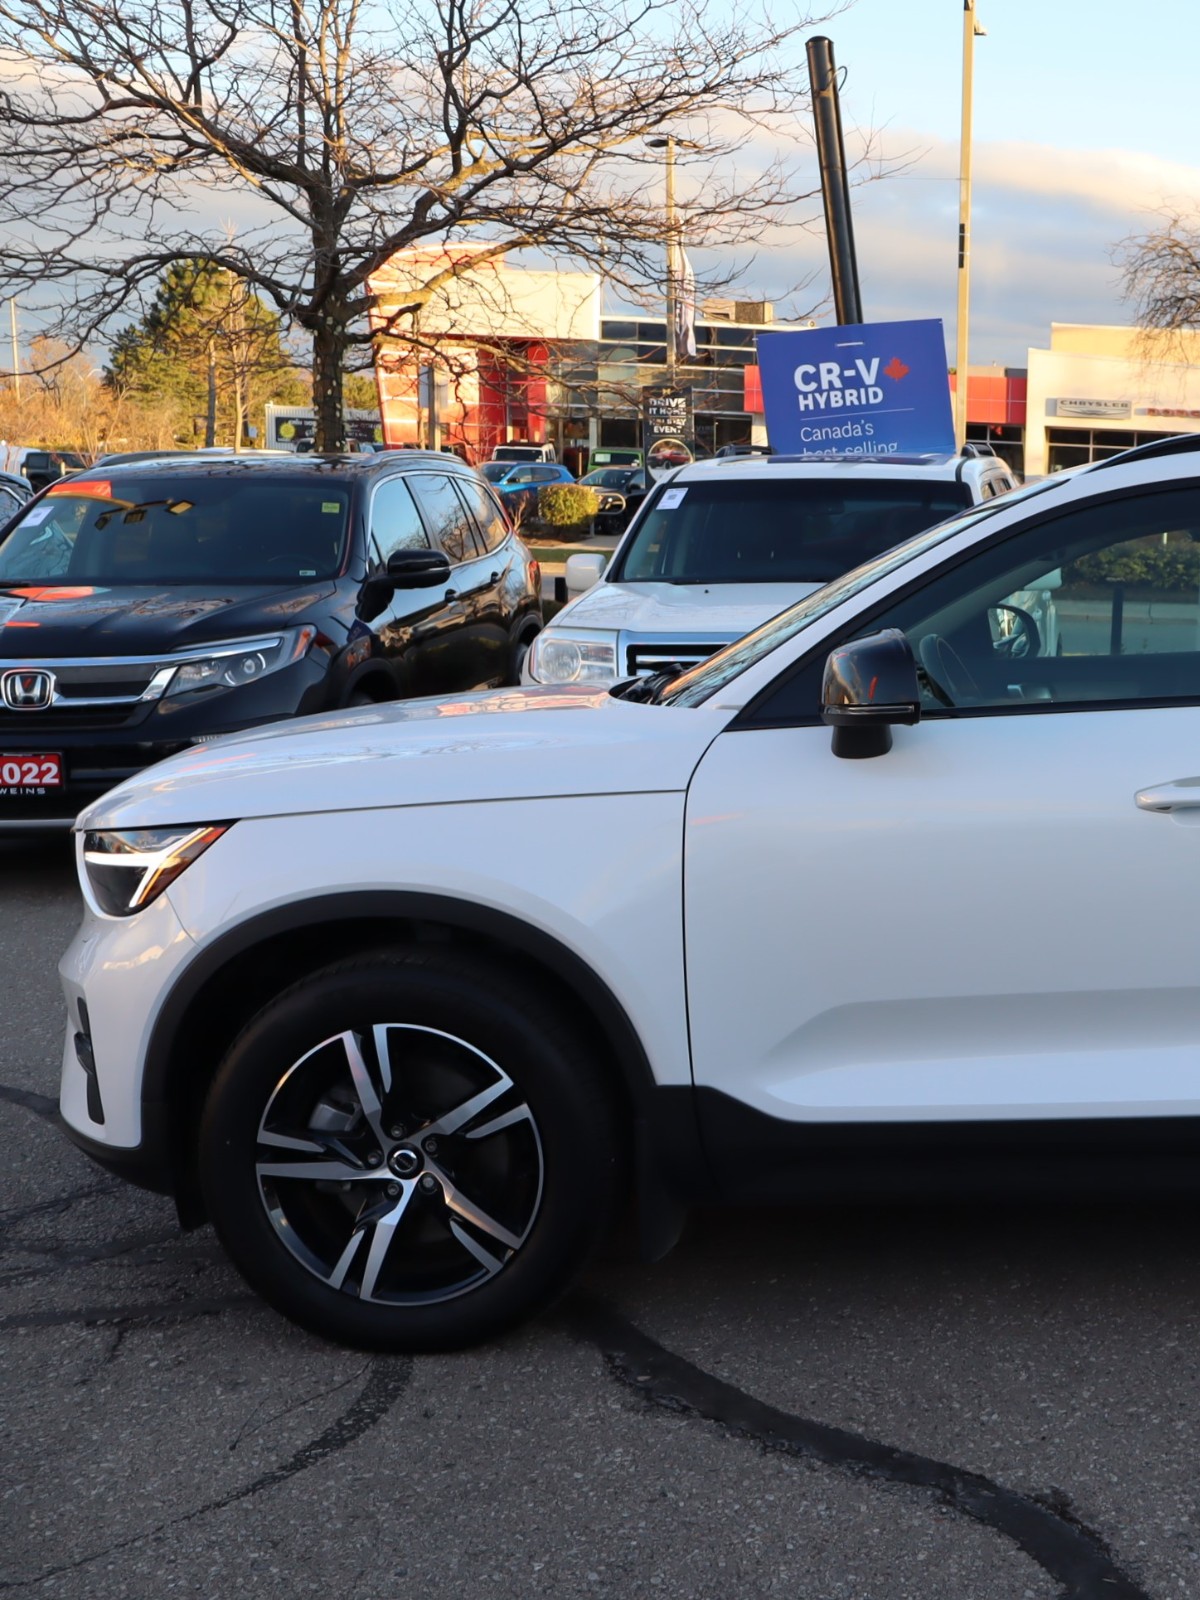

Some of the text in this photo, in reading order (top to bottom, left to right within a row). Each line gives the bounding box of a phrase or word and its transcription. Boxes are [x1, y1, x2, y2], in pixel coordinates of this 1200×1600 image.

[793, 356, 881, 393] CR-V
[649, 397, 687, 408] DRIVE
[797, 386, 884, 412] HYBRID
[1060, 400, 1129, 409] CHRYSLER
[648, 407, 658, 415] IT
[653, 425, 683, 434] EVENT
[800, 419, 874, 442] Canada's
[0, 762, 59, 785] 022
